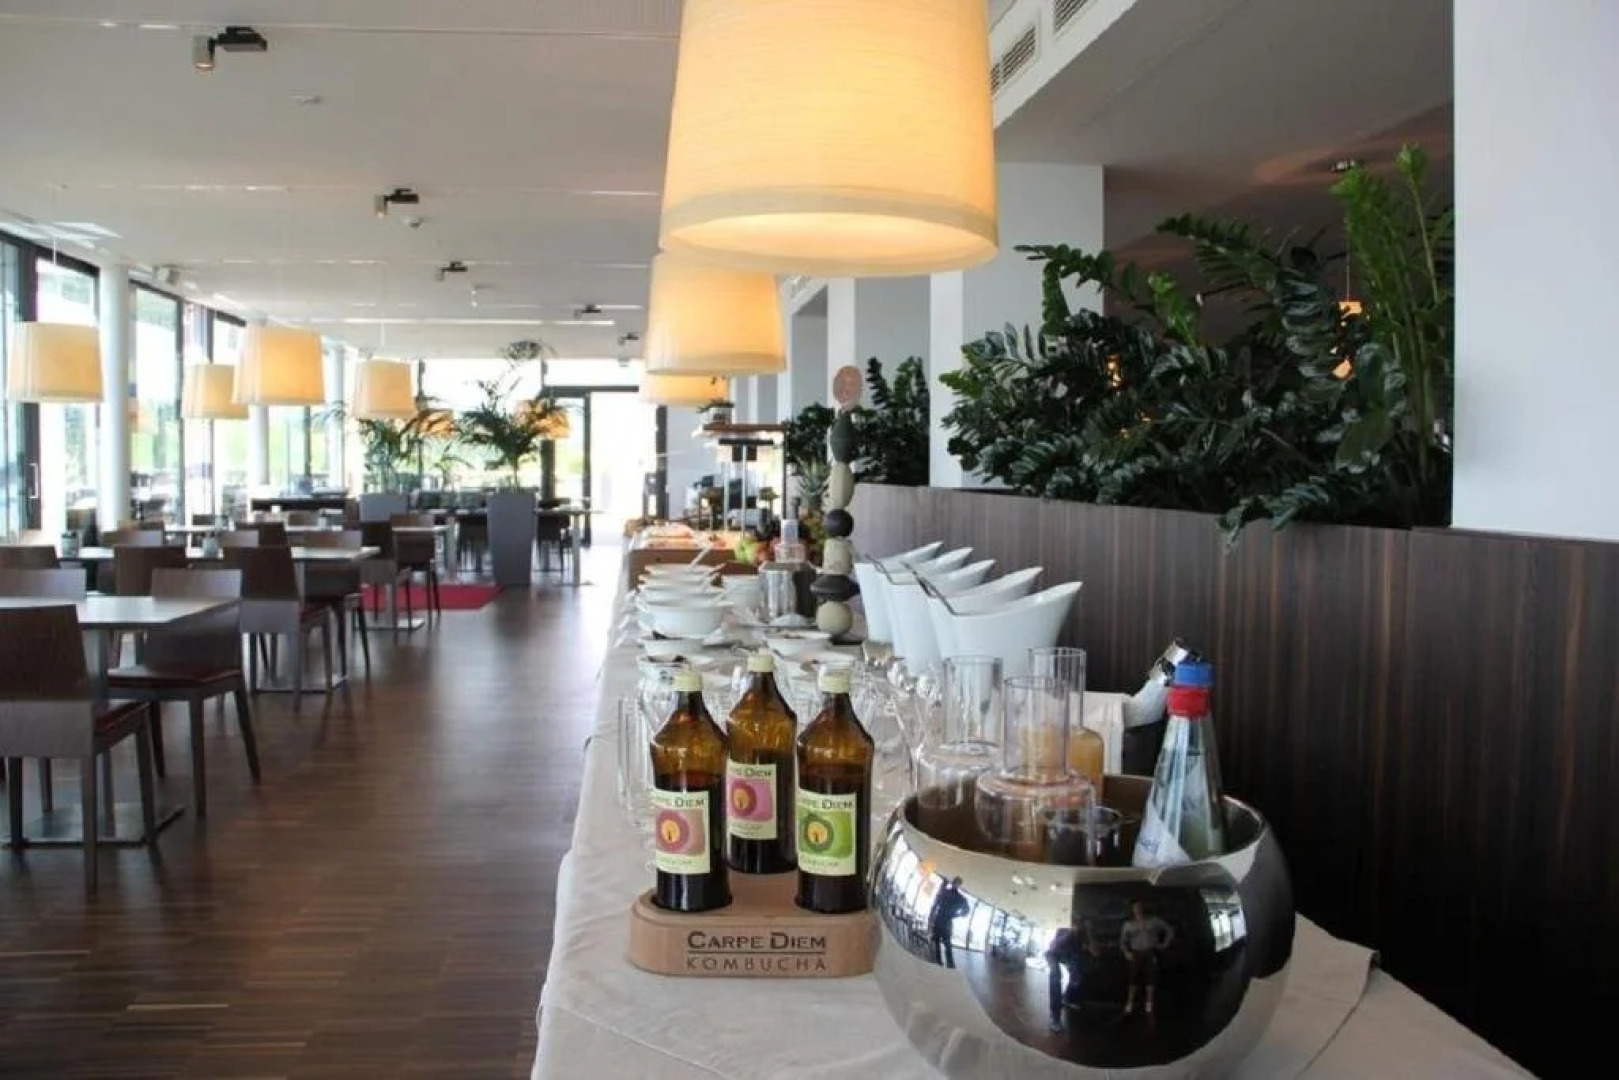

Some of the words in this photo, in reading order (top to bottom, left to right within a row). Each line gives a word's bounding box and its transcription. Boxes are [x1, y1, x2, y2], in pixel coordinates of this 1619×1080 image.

[687, 930, 764, 949] CARPE
[770, 930, 826, 949] DIEM
[686, 956, 827, 971] KOMBUCHA
